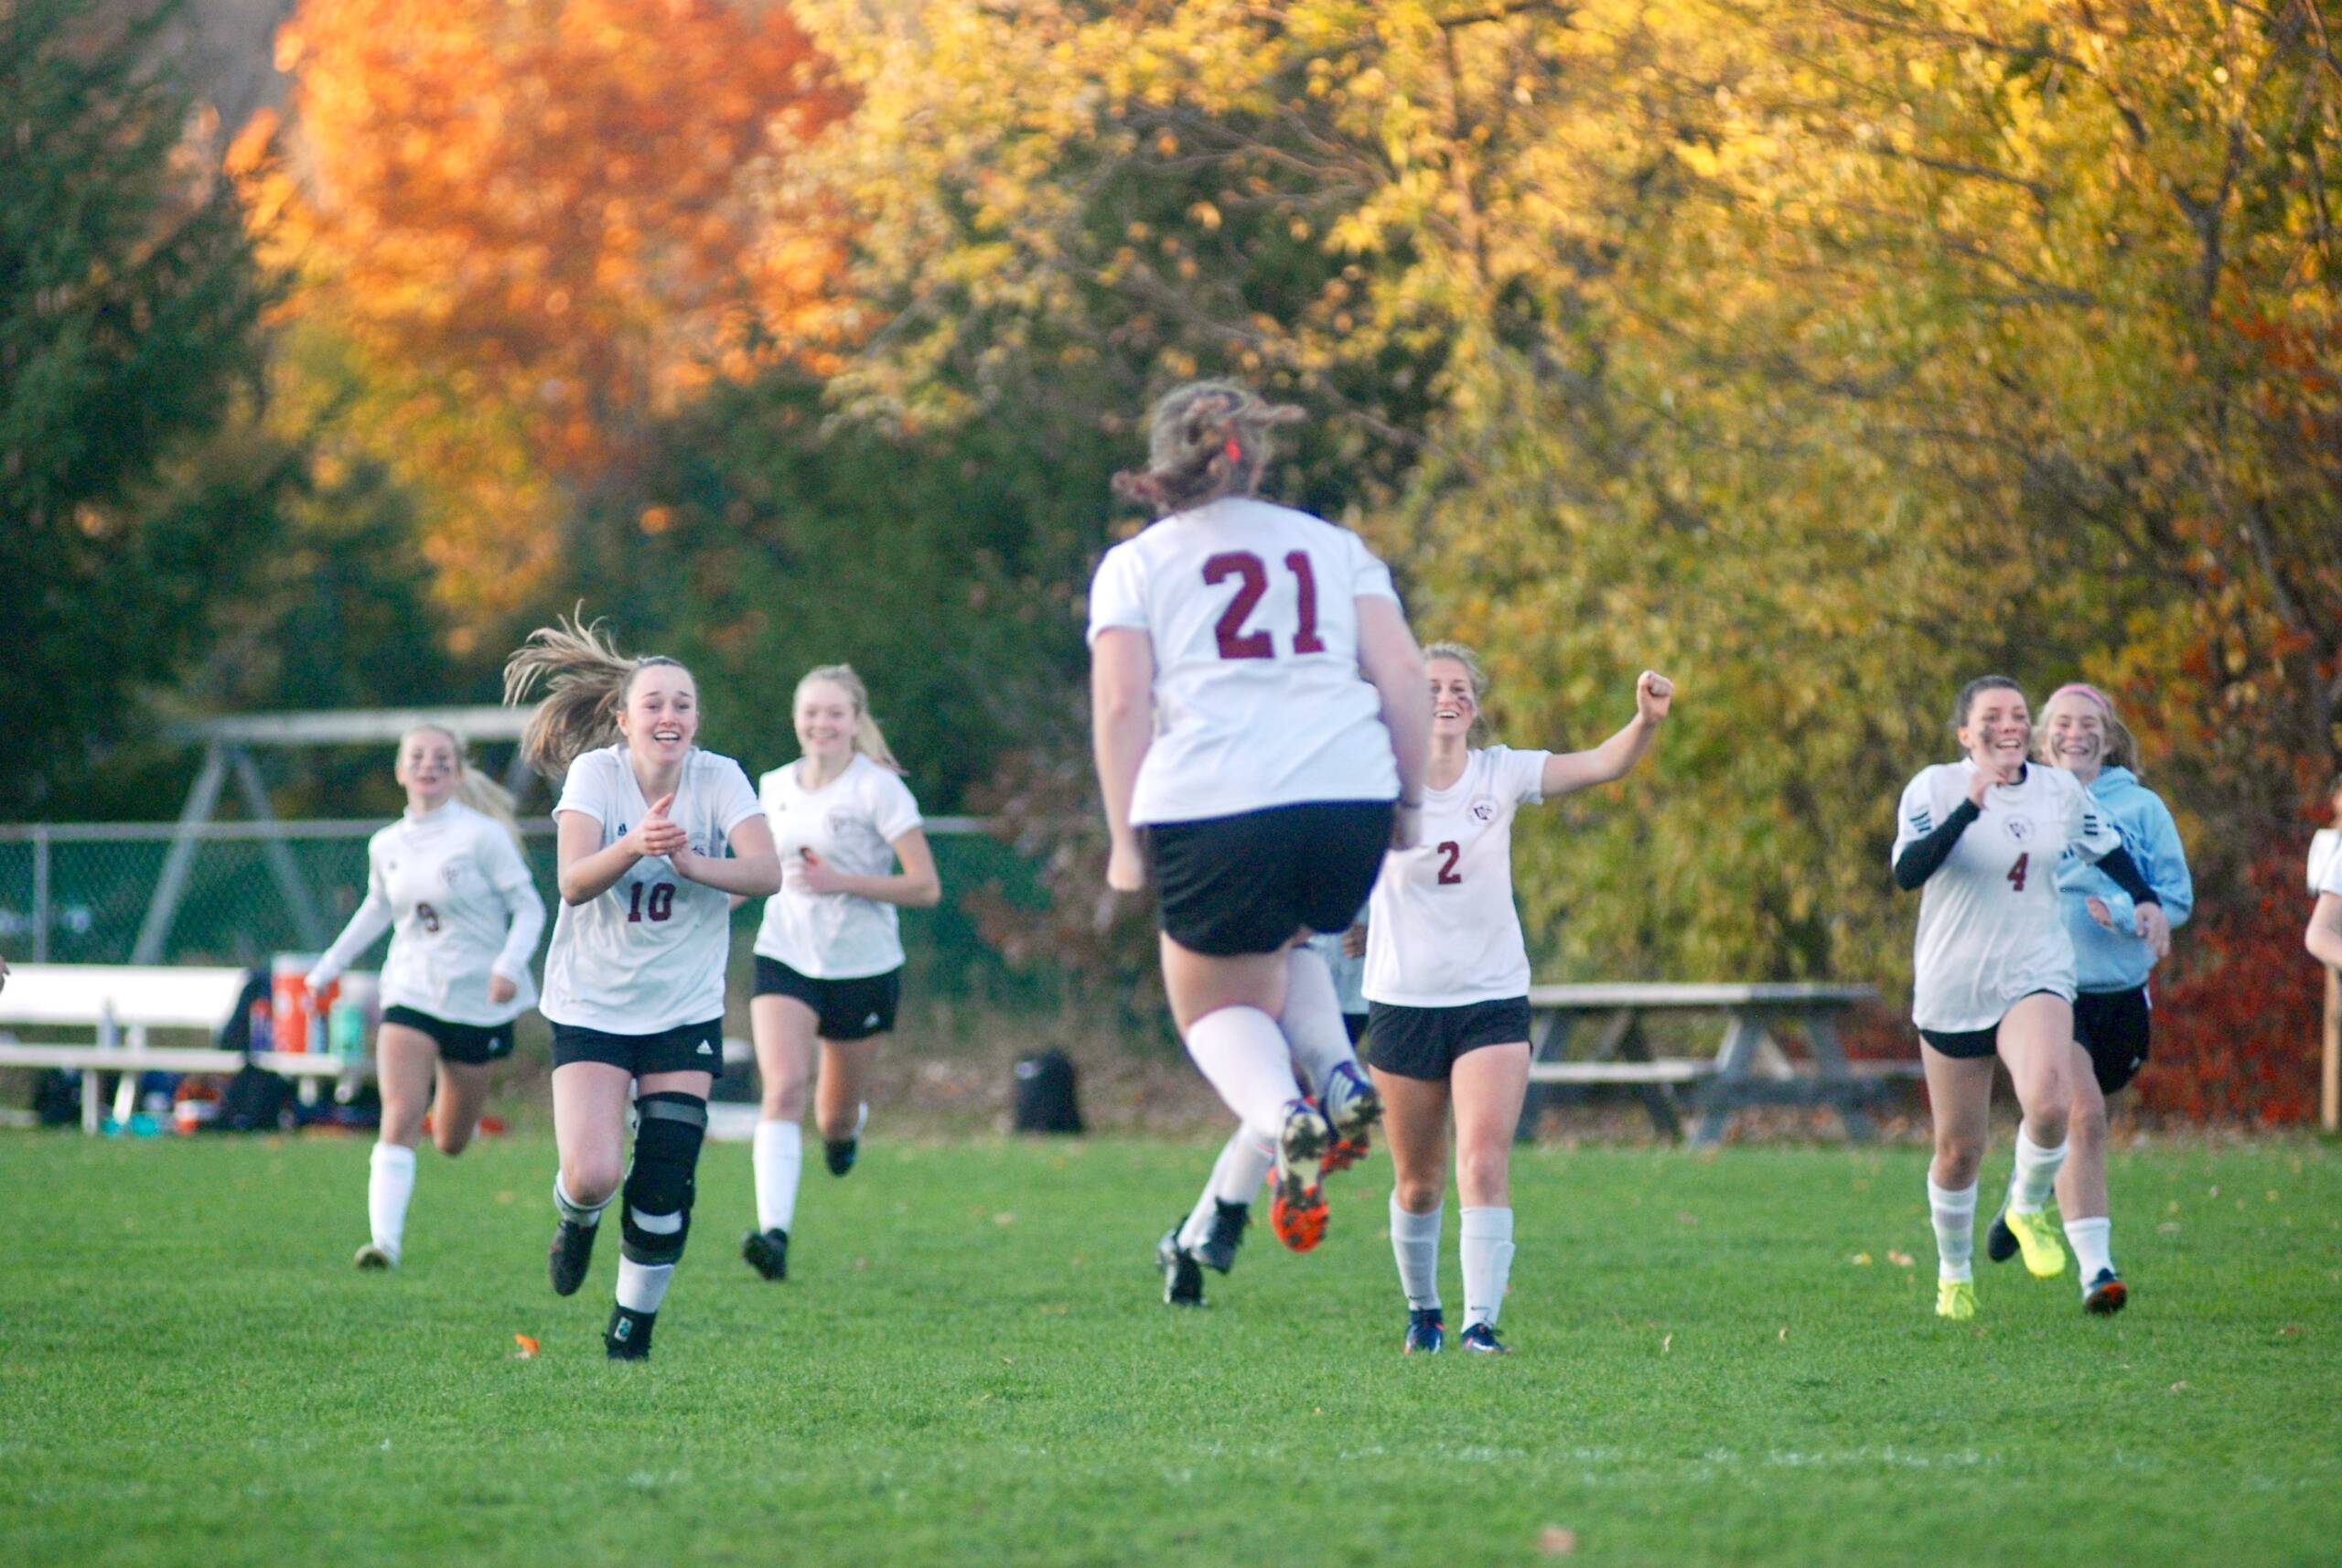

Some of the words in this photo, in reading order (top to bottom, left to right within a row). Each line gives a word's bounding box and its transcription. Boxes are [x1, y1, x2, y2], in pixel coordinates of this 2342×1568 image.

[1202, 550, 1326, 659] 21
[1437, 841, 1462, 886] 2
[2007, 852, 2029, 892] 4
[628, 882, 675, 922] 10
